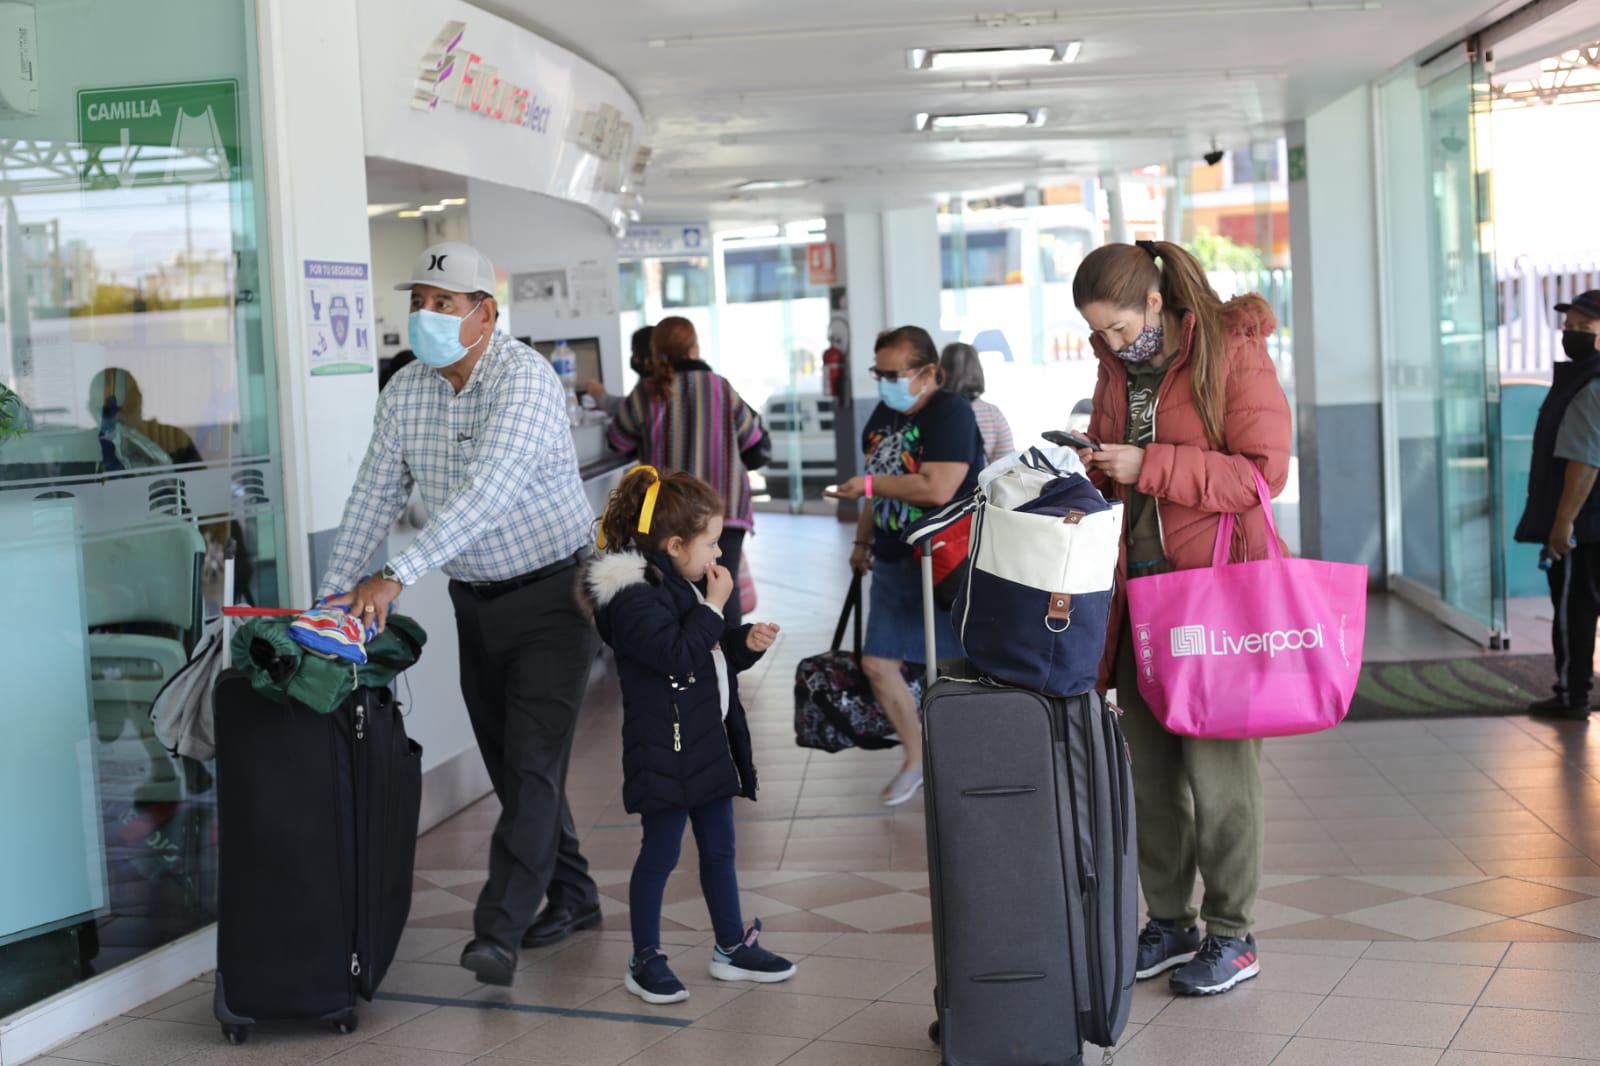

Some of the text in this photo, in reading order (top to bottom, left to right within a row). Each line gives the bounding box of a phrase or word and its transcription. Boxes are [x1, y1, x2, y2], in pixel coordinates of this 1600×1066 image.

[87, 98, 162, 122] CAMILLA
[310, 263, 322, 275] POR
[1210, 623, 1324, 659] Liverpool
